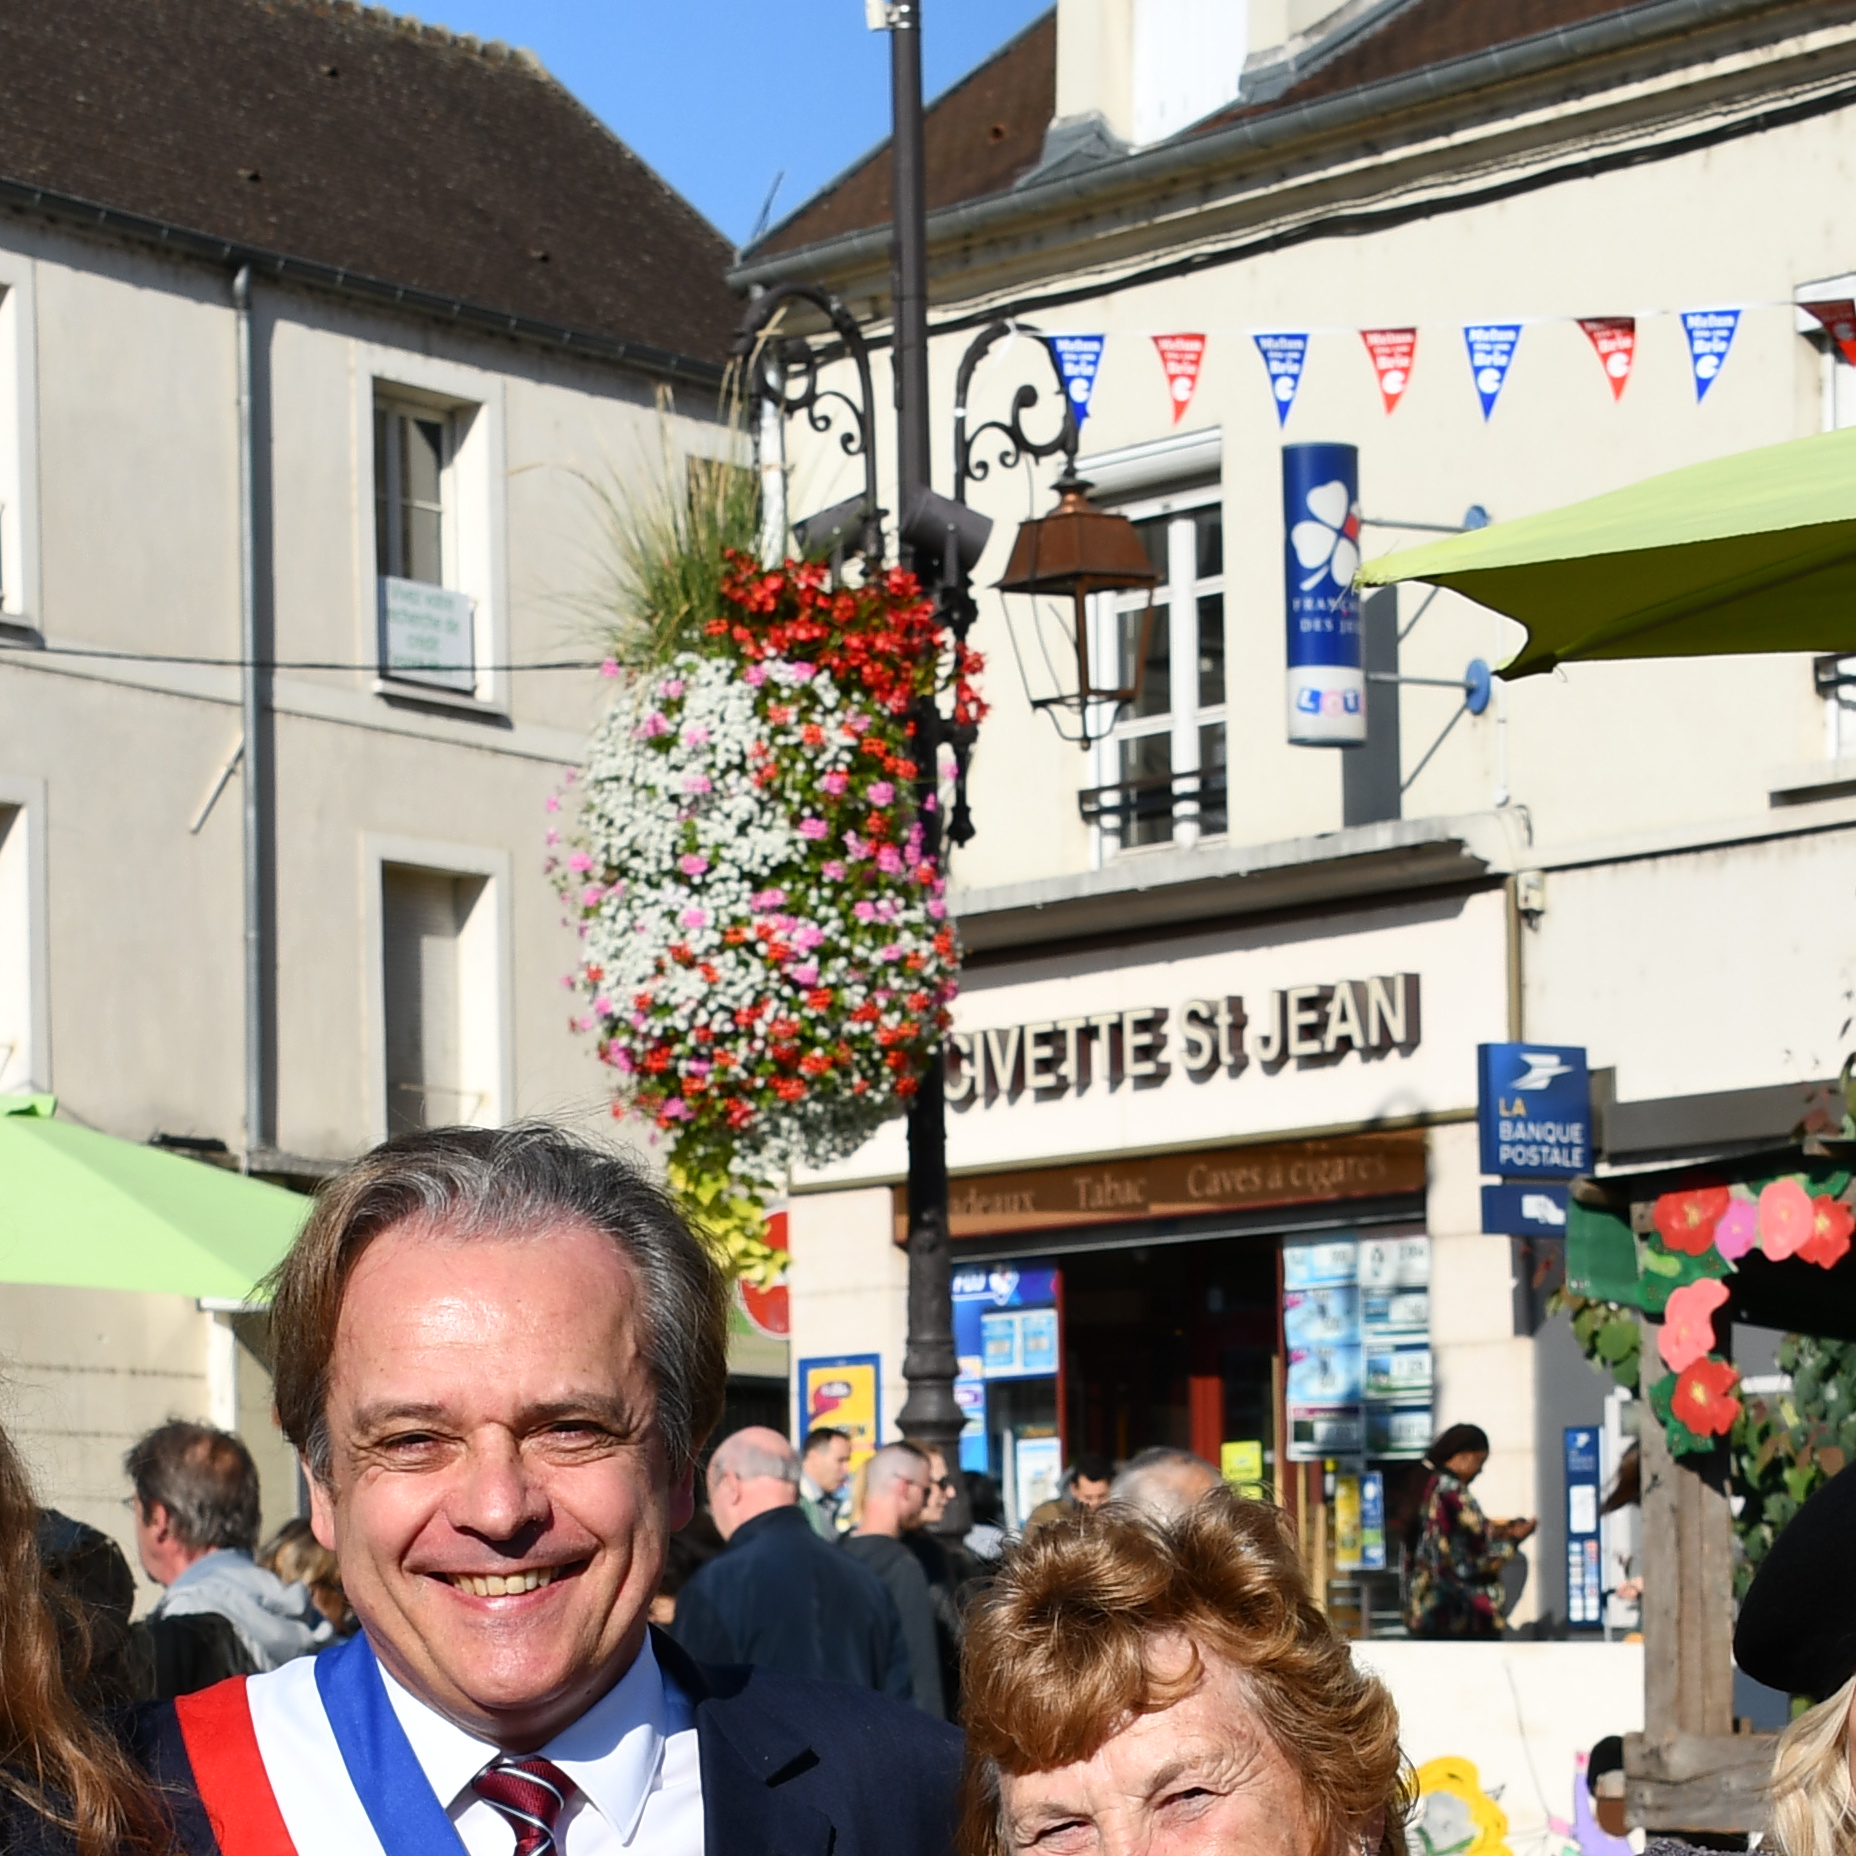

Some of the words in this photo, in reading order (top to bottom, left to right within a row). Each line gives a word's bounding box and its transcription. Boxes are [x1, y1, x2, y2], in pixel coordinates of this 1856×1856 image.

[944, 1008, 1164, 1102] CIVETTE
[1180, 996, 1241, 1072] St
[1255, 973, 1418, 1063] JEAN
[1498, 1096, 1528, 1118] LA
[1498, 1119, 1585, 1145] BANQUE
[1498, 1143, 1585, 1169] POSTALE
[950, 1187, 1034, 1215] adeaux
[1074, 1174, 1148, 1209] Tabac
[1187, 1163, 1261, 1198] Caves
[1268, 1157, 1283, 1190] à
[1289, 1152, 1388, 1194] cigares
